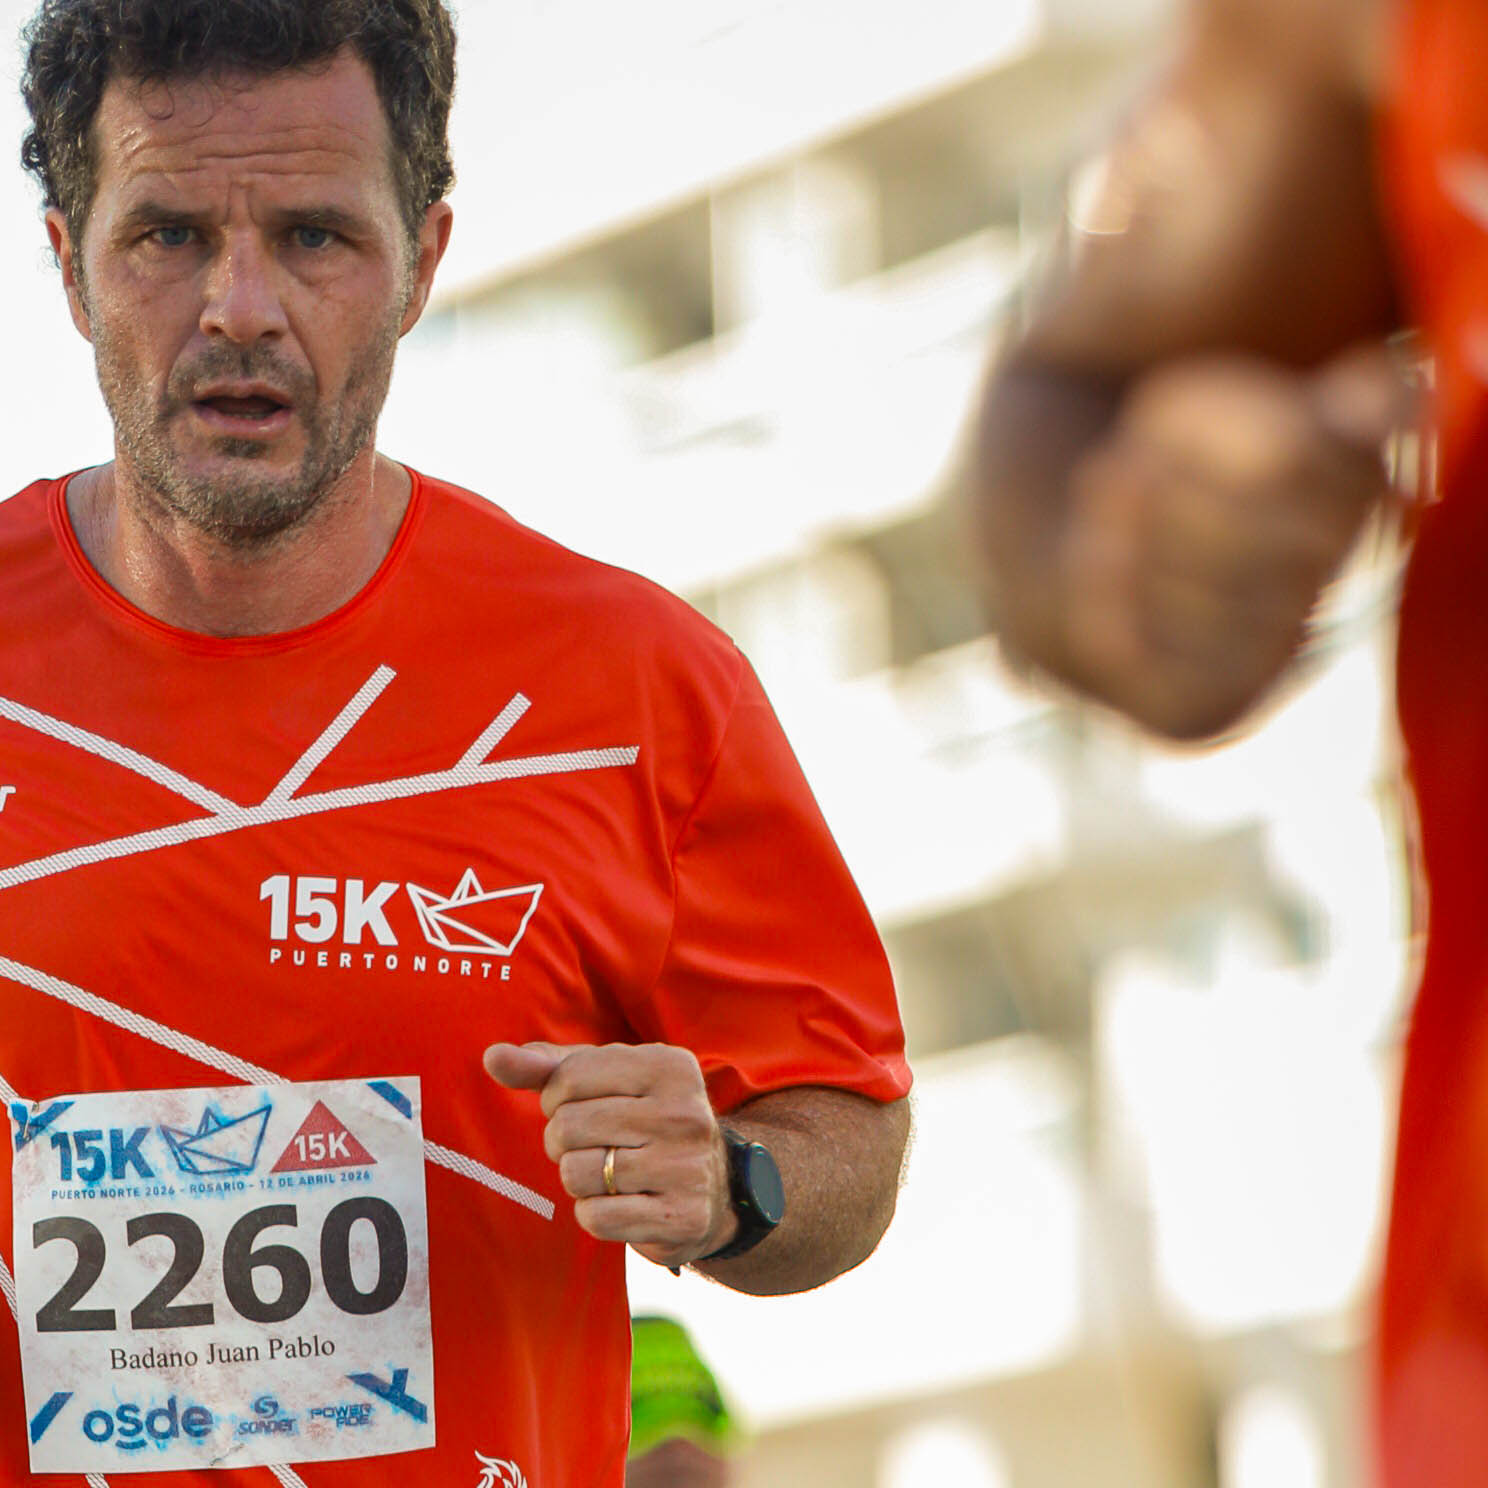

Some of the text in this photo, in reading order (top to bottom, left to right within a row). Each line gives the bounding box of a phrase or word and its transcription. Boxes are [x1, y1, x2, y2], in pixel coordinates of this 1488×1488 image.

[259, 874, 401, 947] 15K
[269, 948, 512, 981] PUERTO NORTE
[50, 1126, 156, 1182] 15K
[294, 1130, 351, 1162] 15K
[51, 1189, 96, 1200] PUERTO
[100, 1187, 140, 1199] NORTE
[145, 1185, 176, 1196] 2026
[190, 1180, 245, 1194] ROSARIO
[260, 1178, 273, 1189] 12
[279, 1176, 294, 1188] DE
[299, 1174, 336, 1186] ABRIL
[340, 1170, 371, 1182] 2026
[32, 1196, 409, 1333] 2260
[110, 1335, 336, 1370] Badano Juan Pablo
[83, 1395, 215, 1443] osde
[310, 1403, 372, 1420] POWER
